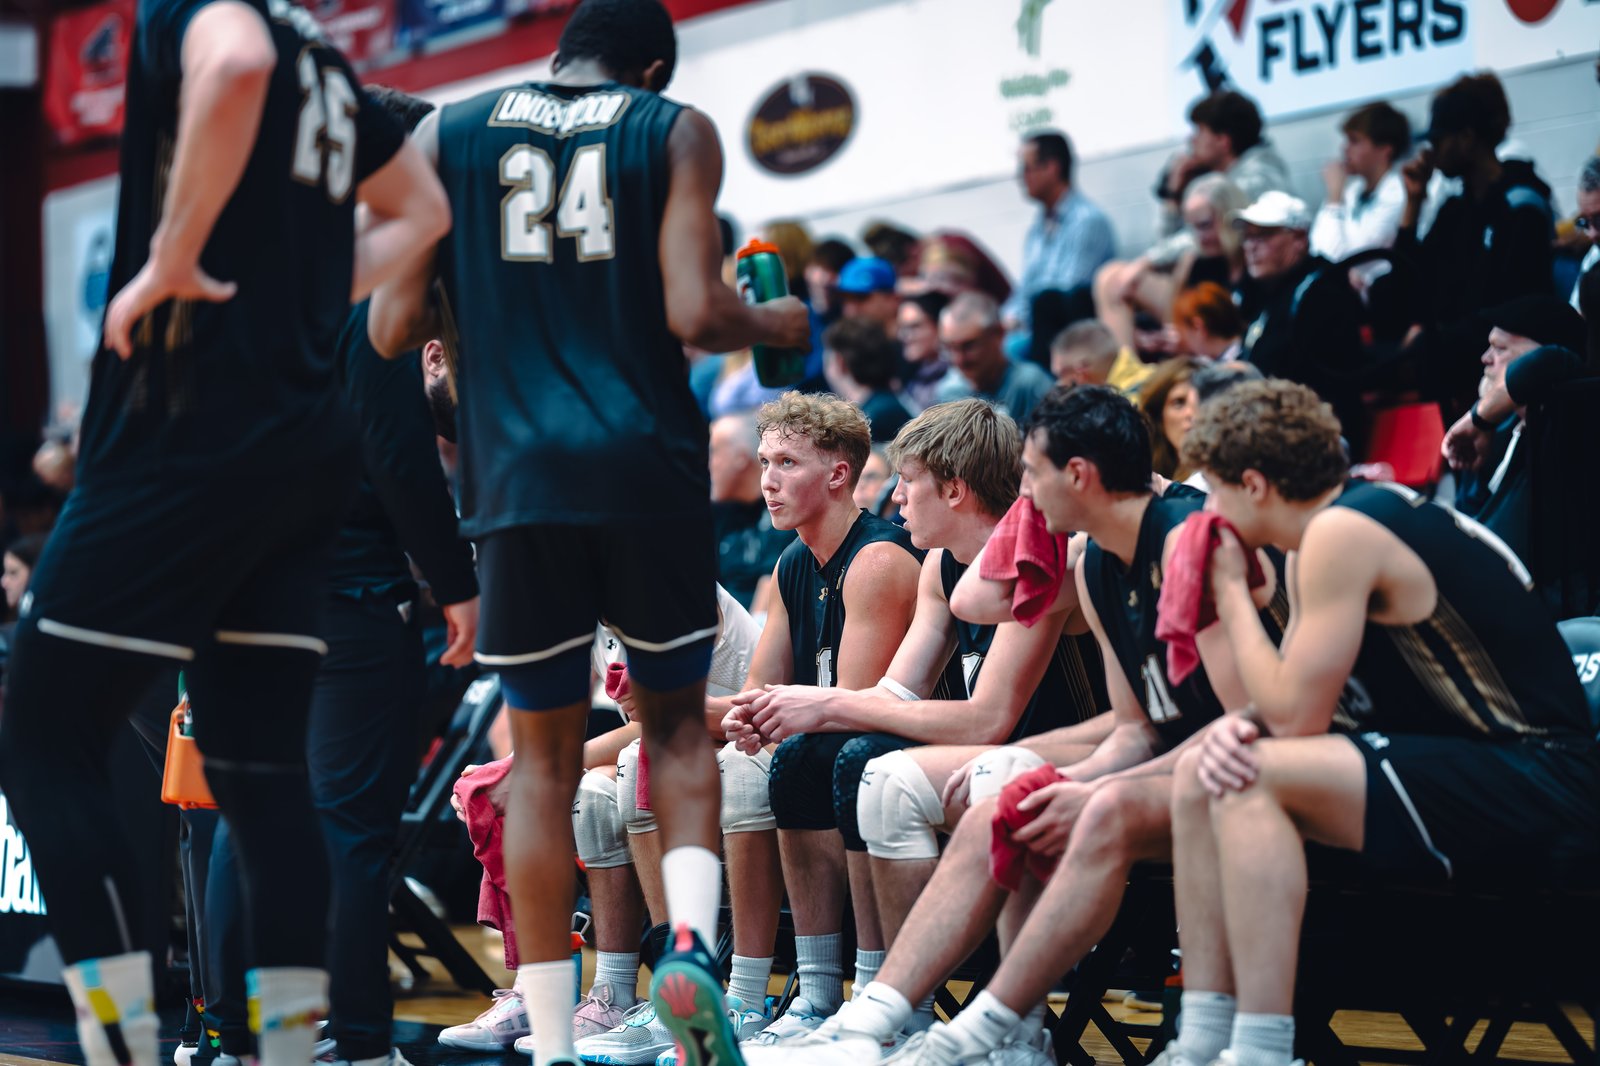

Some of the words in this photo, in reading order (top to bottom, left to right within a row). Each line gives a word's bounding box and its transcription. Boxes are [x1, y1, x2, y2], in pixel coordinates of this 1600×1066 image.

[1256, 0, 1467, 82] FLYERS
[293, 45, 358, 205] 25
[496, 89, 627, 133] LINDEWOOD
[499, 142, 615, 264] 24
